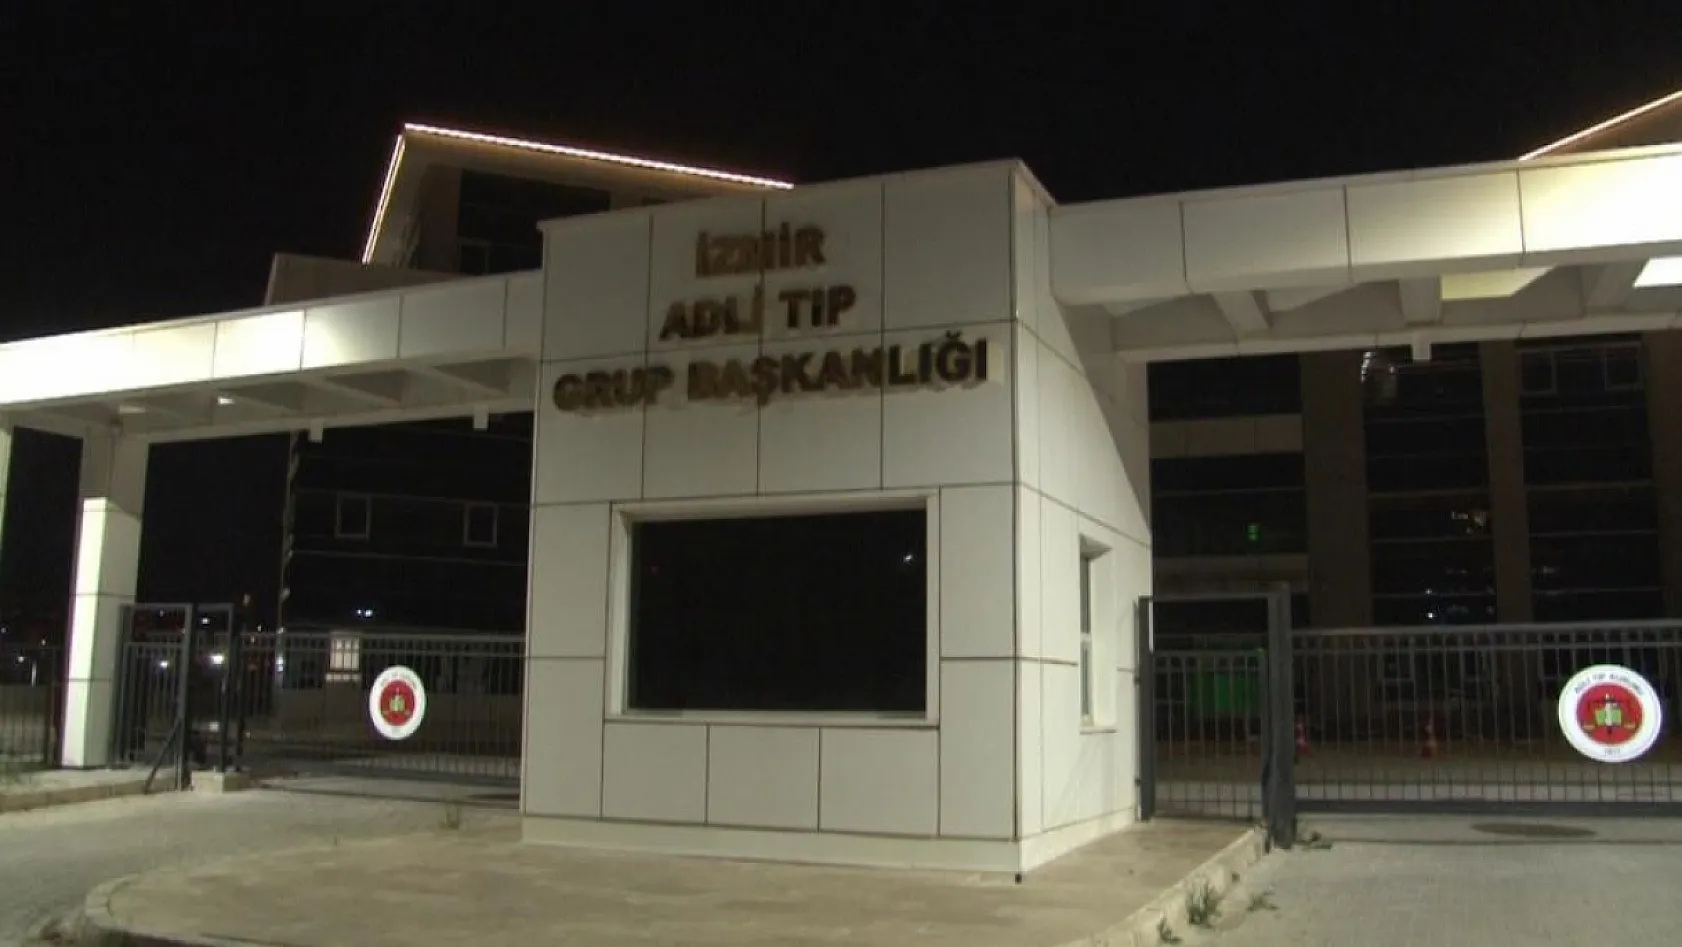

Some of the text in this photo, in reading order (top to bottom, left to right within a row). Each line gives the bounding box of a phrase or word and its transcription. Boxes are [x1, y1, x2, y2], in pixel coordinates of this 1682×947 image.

[696, 221, 826, 278] İZMİR
[659, 284, 856, 340] ADLİ TIP
[553, 330, 988, 412] GRUP BAŞKANLIĞI
